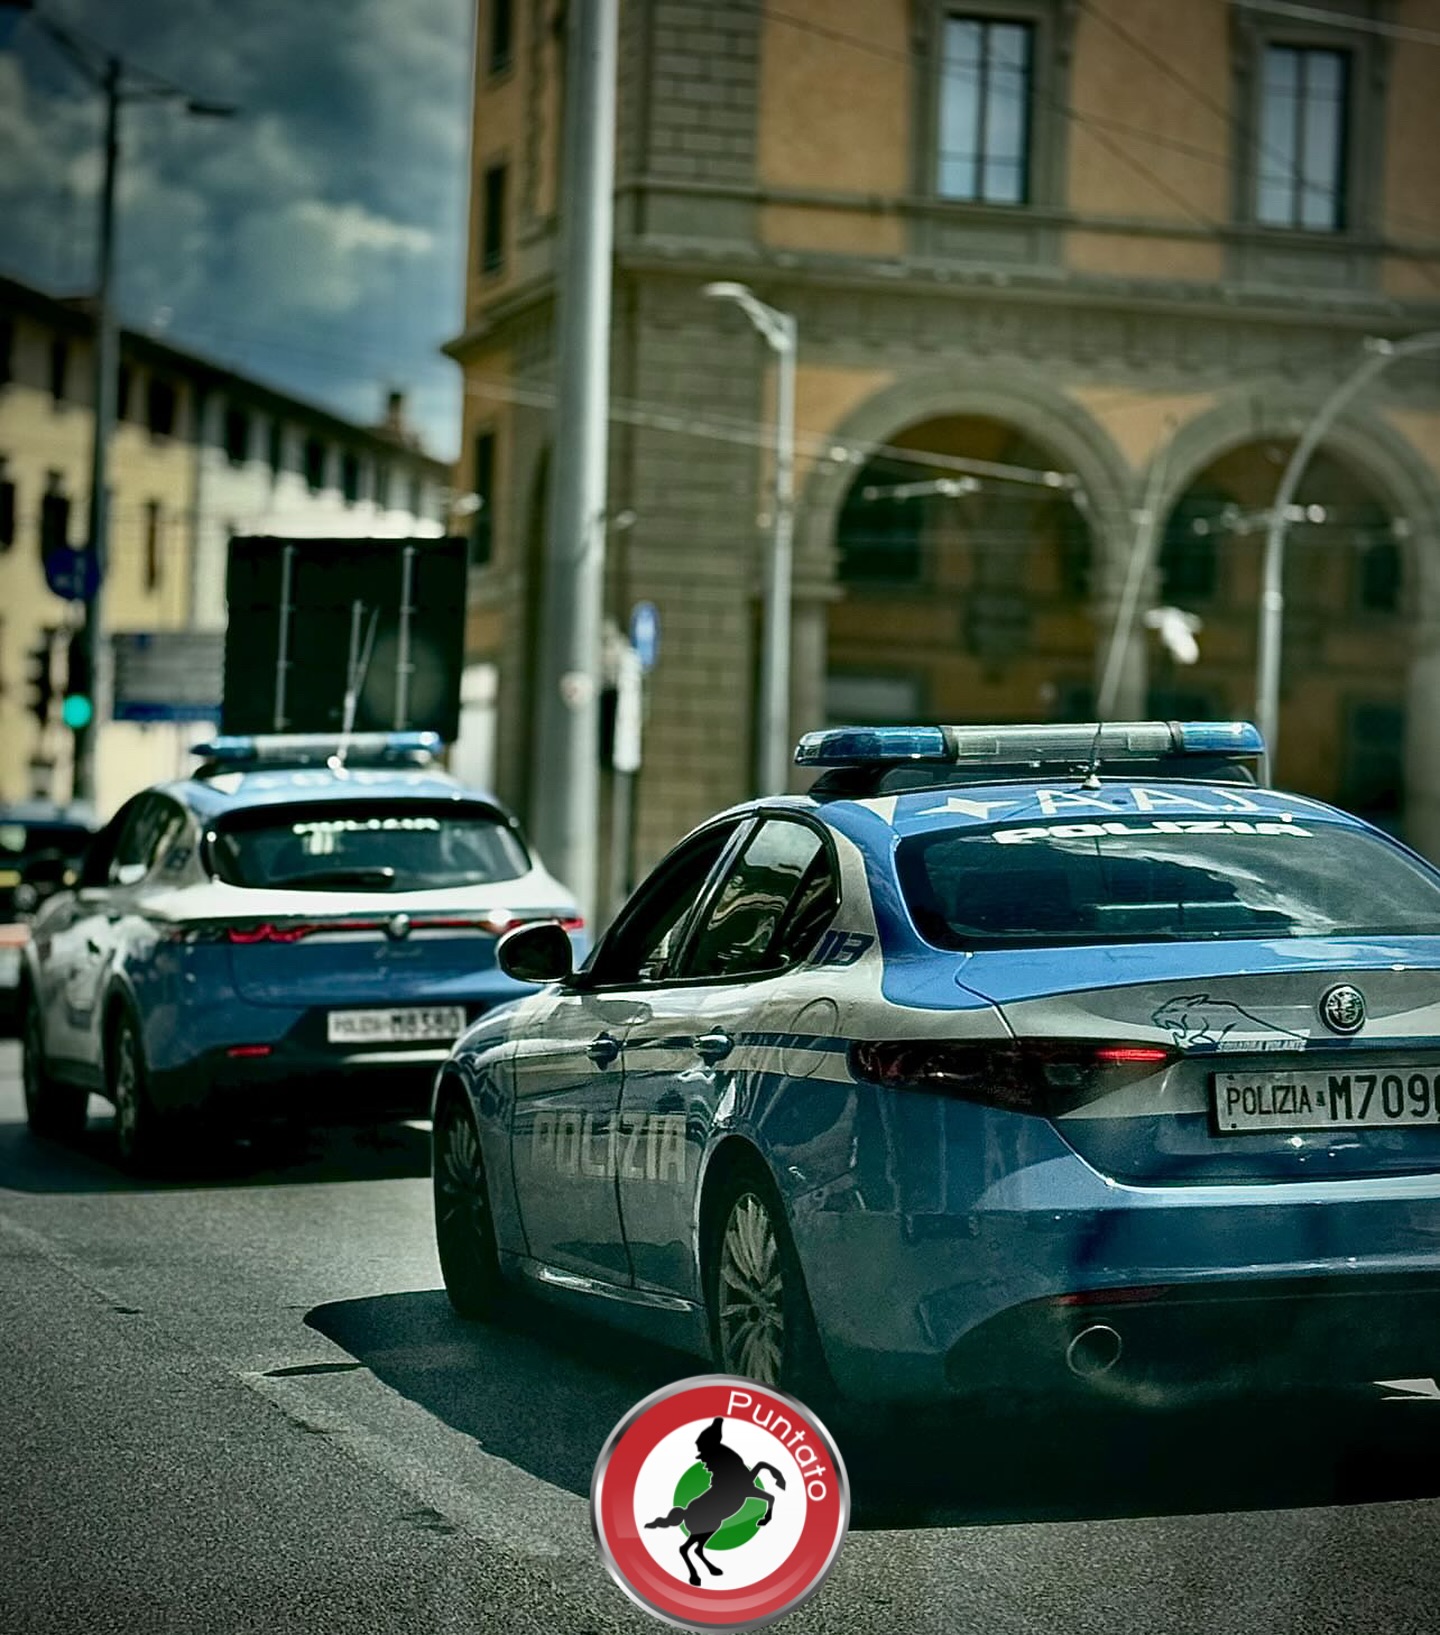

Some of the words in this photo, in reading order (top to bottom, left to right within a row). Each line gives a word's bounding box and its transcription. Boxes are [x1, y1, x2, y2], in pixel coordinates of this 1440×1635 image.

[991, 820, 1313, 845] POLIZIA
[812, 929, 875, 966] 113
[1226, 1085, 1313, 1116] POLIZIA
[1328, 1073, 1440, 1121] M709
[530, 1111, 687, 1183] POLIZIA
